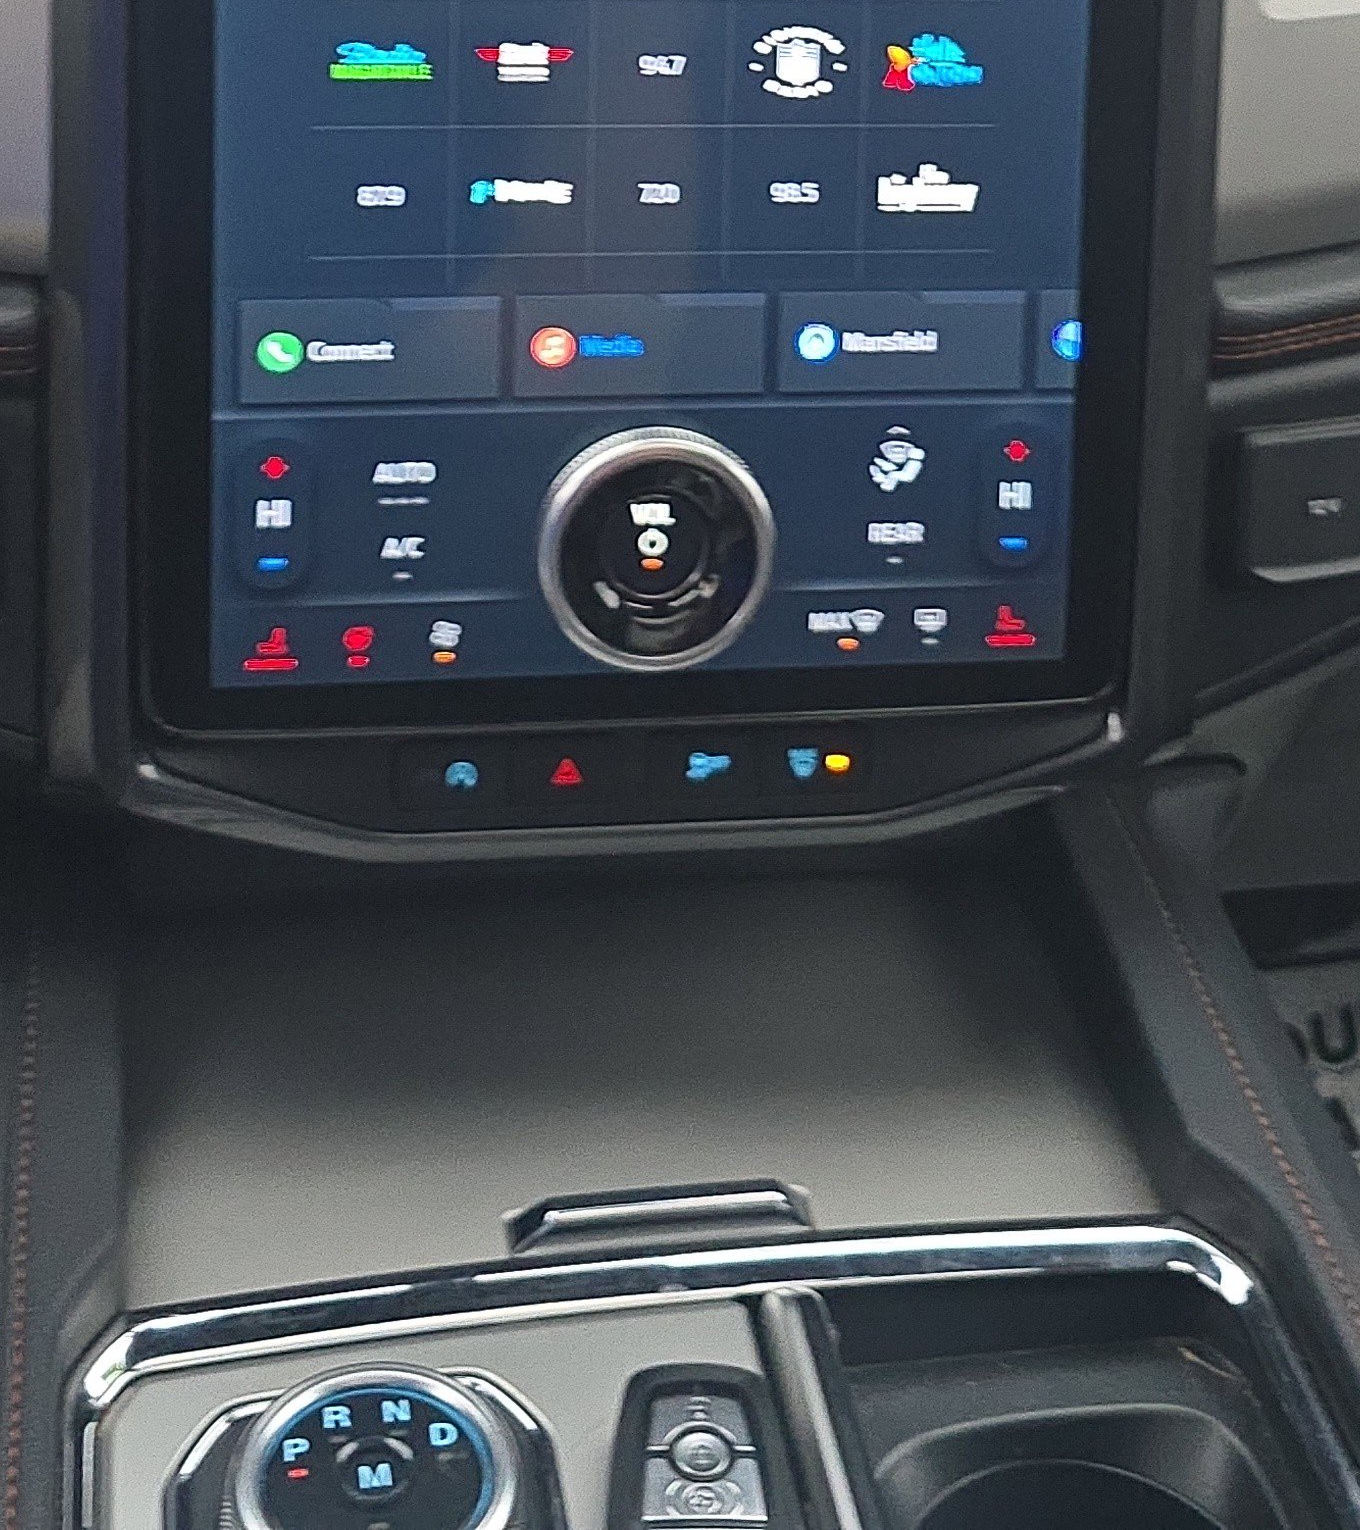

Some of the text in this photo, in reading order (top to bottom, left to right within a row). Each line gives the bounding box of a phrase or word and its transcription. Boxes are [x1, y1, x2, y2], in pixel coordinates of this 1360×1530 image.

[321, 1406, 352, 1430] R
[381, 1400, 411, 1424] N
[428, 1422, 458, 1448] D
[282, 1438, 311, 1463] P
[357, 1463, 393, 1490] M
